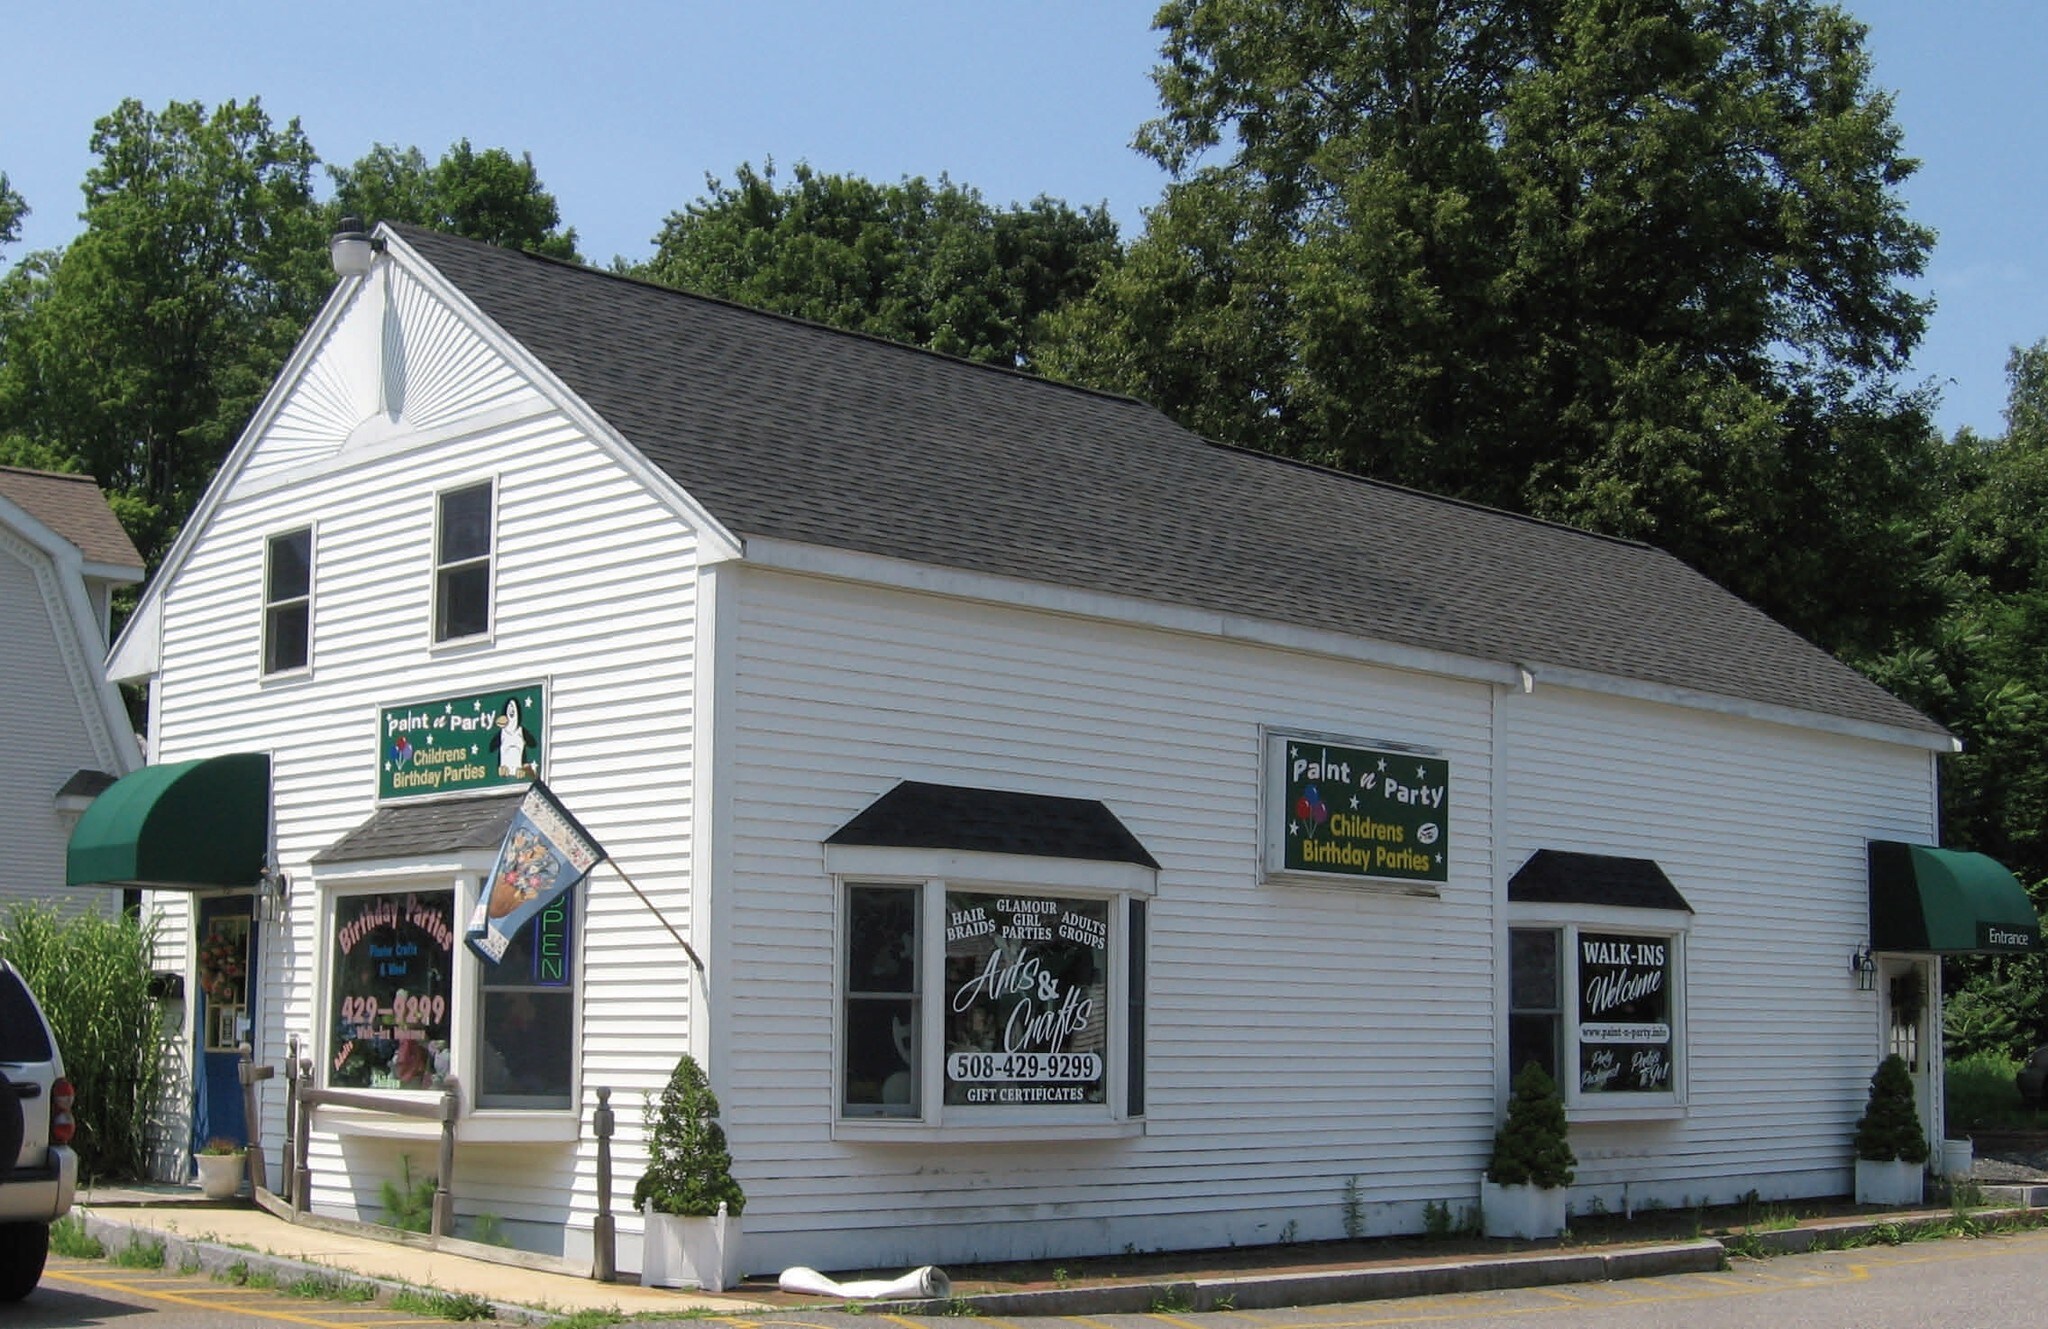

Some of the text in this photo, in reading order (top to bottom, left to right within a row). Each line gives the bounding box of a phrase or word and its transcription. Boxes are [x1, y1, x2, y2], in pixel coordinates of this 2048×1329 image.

[388, 711, 428, 737] Paint
[450, 710, 496, 731] Party
[413, 749, 467, 766] Childrens
[393, 765, 486, 788] Birthday Parties
[1293, 748, 1351, 783] Paint
[1384, 777, 1444, 808] Party
[1330, 813, 1404, 843] Childrens
[1303, 840, 1430, 872] Birthday Parties
[952, 908, 986, 926] HAIR
[996, 899, 1057, 914] GLAMOUR
[339, 893, 453, 955] Birthday Parties
[947, 919, 996, 941] BRAIDS
[1013, 914, 1041, 926] GIRL
[1061, 911, 1106, 935] ADULTS
[1002, 926, 1052, 940] PARTIES
[1059, 925, 1105, 949] GROUPS
[1989, 928, 2028, 945] Entrance
[1583, 942, 1664, 966] WALK-INS
[953, 947, 1060, 1012] Arts &
[1586, 968, 1662, 1015] Welcome
[1004, 985, 1092, 1054] Crafts
[957, 1055, 1094, 1078] 508-429-9299
[967, 1087, 1084, 1102] GIFT CERTIFICATES
